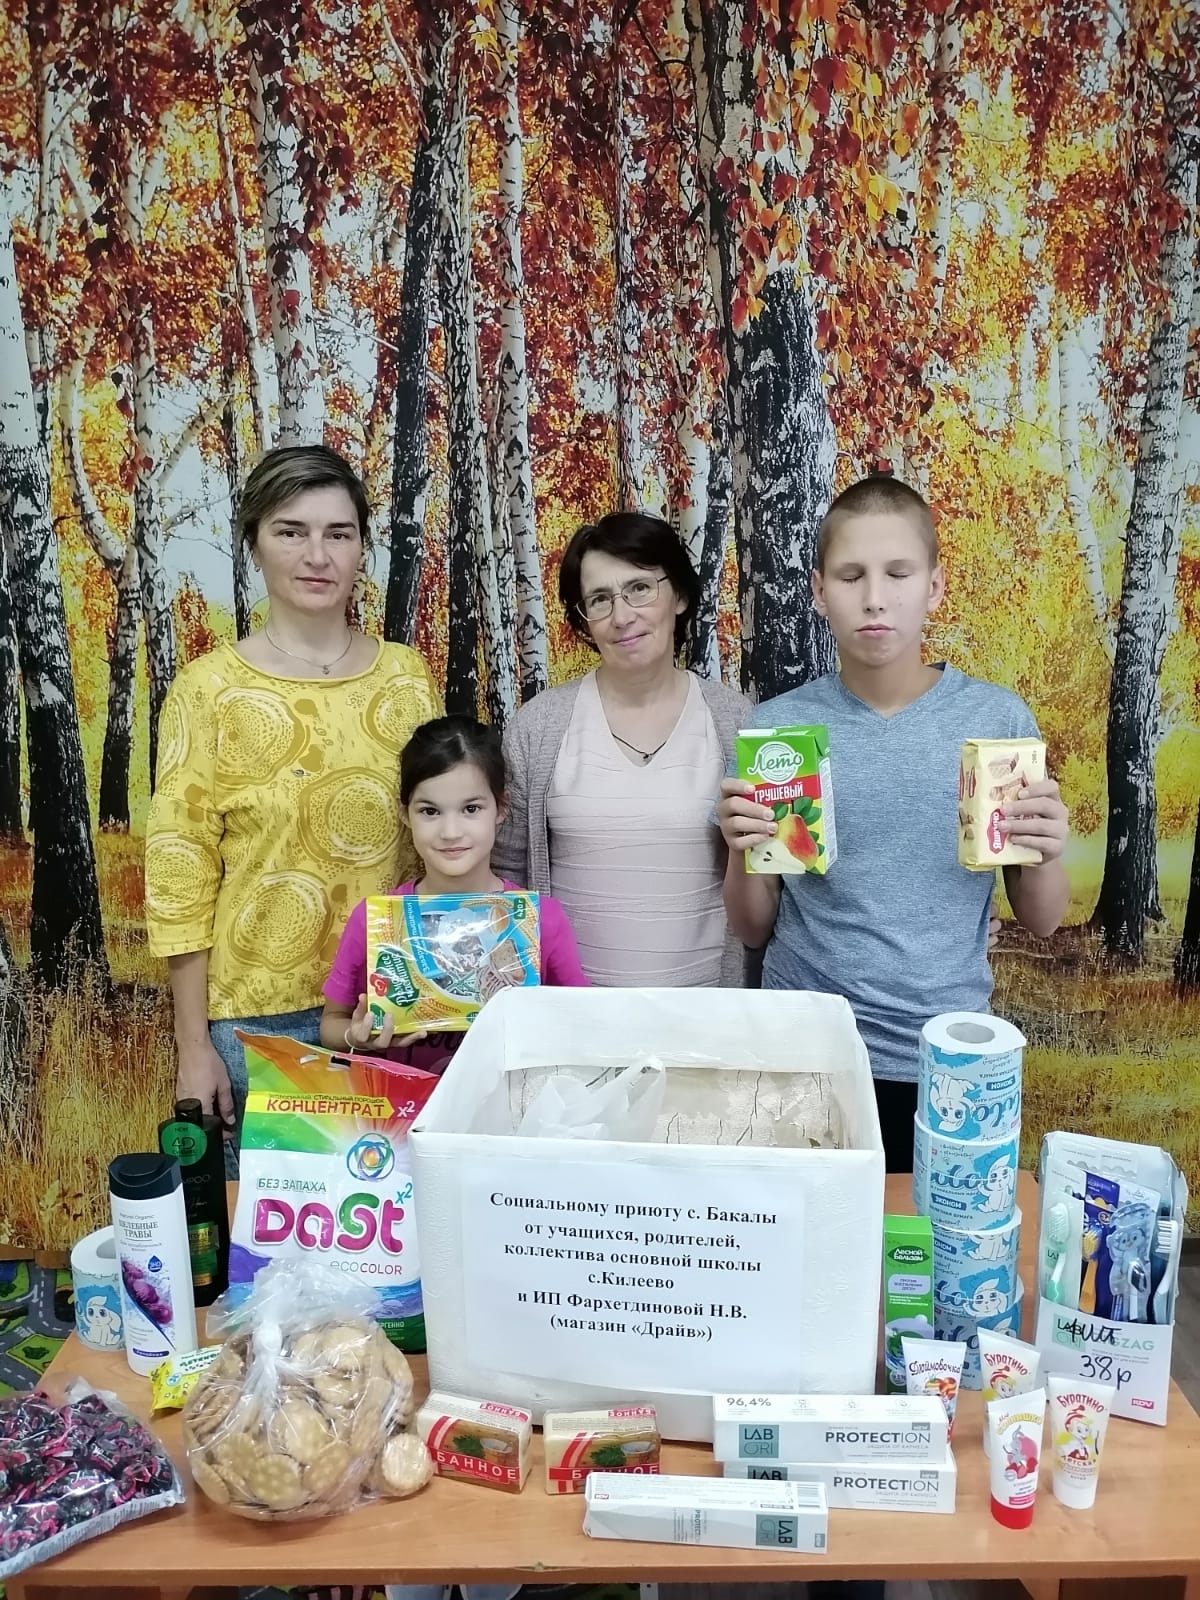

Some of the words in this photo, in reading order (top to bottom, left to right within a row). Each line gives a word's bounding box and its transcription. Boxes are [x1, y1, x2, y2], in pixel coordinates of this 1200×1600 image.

[749, 752, 802, 773] Лето
[754, 781, 804, 803] ГРУШЕВЫЙ
[267, 1099, 385, 1117] КОНЦЕНТРАТ
[257, 1178, 280, 1189] БЕЗ
[282, 1179, 327, 1193] ЗАПАХА
[490, 1192, 609, 1217] Социальному
[615, 1204, 682, 1222] приюту
[687, 1208, 700, 1220] с.
[707, 1206, 777, 1224] Бакалы
[124, 1229, 153, 1239] ТРАВЫ
[524, 1223, 543, 1234] от
[548, 1225, 639, 1244] учащихся,
[644, 1231, 741, 1250] родителей,
[504, 1244, 605, 1262] коллектива
[610, 1252, 692, 1268] основной
[698, 1259, 761, 1272] школы
[588, 1271, 675, 1289] с.Килеево
[518, 1292, 527, 1302] и
[534, 1290, 561, 1306] ИП
[567, 1294, 704, 1316] Фархетдиновой
[709, 1303, 747, 1319] Н.В.
[550, 1314, 626, 1333] (магазин
[631, 1321, 712, 1342] «Драйв»)
[1097, 1335, 1155, 1351] GZAG
[909, 1358, 961, 1376] Дюймовочка
[984, 1353, 1028, 1376] БУРАТИНО
[726, 1397, 772, 1408] 96,4%
[1056, 1393, 1105, 1413] БУРАТИНО
[744, 1428, 774, 1441] LAB
[825, 1431, 931, 1444] PROTECTION
[435, 1452, 518, 1481] БАННОЕ
[833, 1476, 939, 1492] PROTECTION
[778, 1520, 793, 1545] LAB
